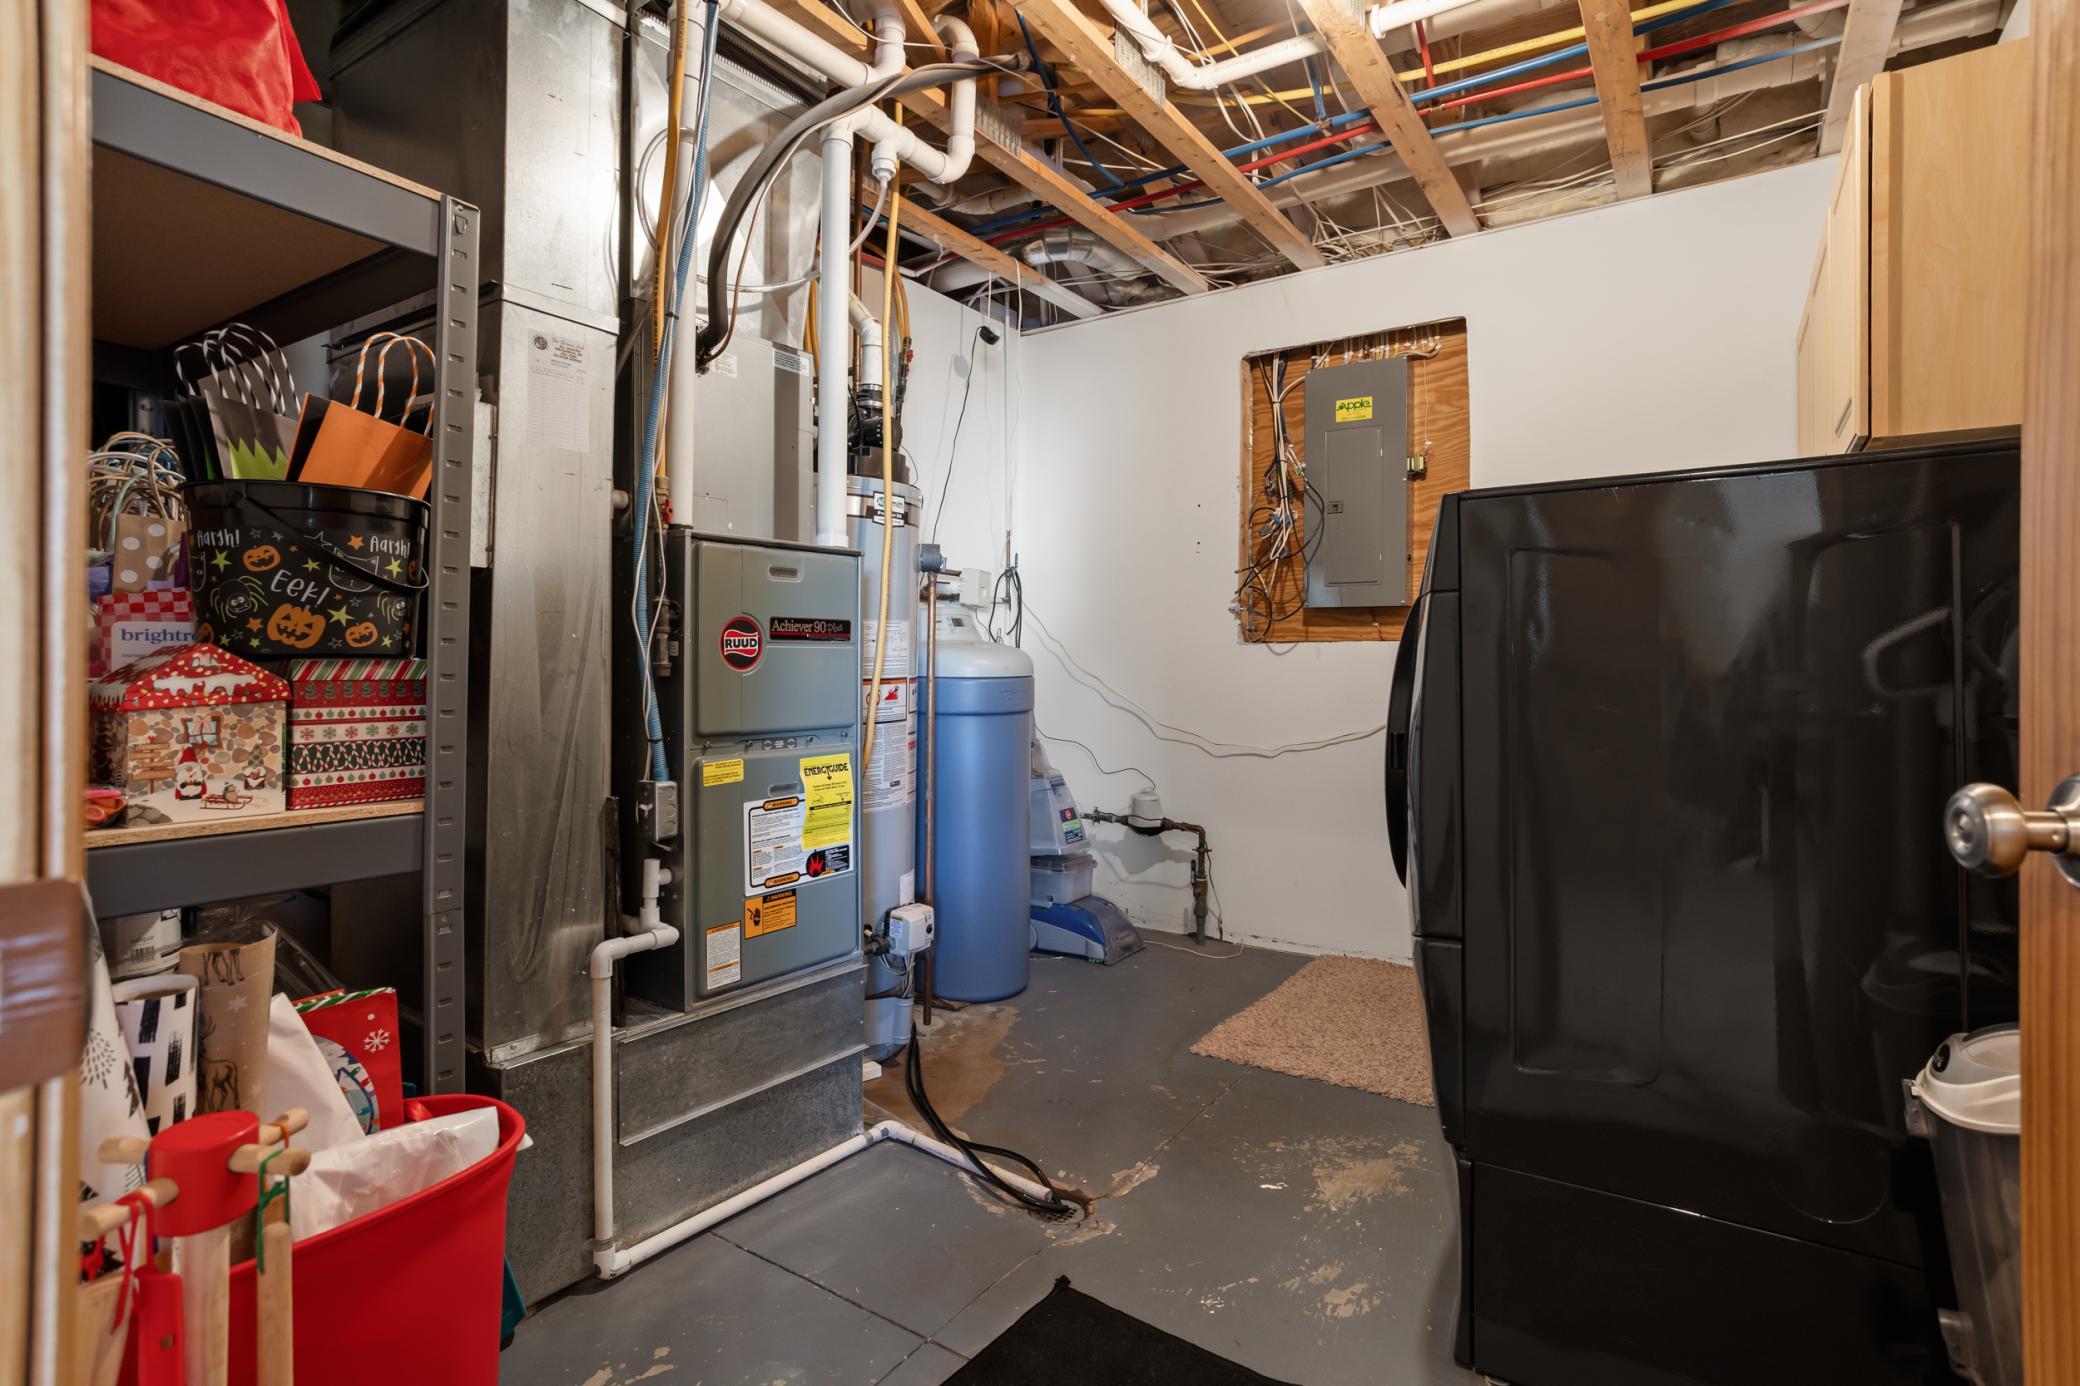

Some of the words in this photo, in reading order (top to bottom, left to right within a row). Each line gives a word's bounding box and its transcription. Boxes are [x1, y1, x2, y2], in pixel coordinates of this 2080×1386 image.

[197, 528, 240, 549] Aargh!
[370, 535, 411, 559] Aargh!
[270, 568, 331, 608] Eek!
[771, 619, 813, 632] Achiever
[814, 620, 826, 633] 90
[725, 638, 757, 649] RUUD
[804, 763, 849, 777] ENERGYGUIDE
